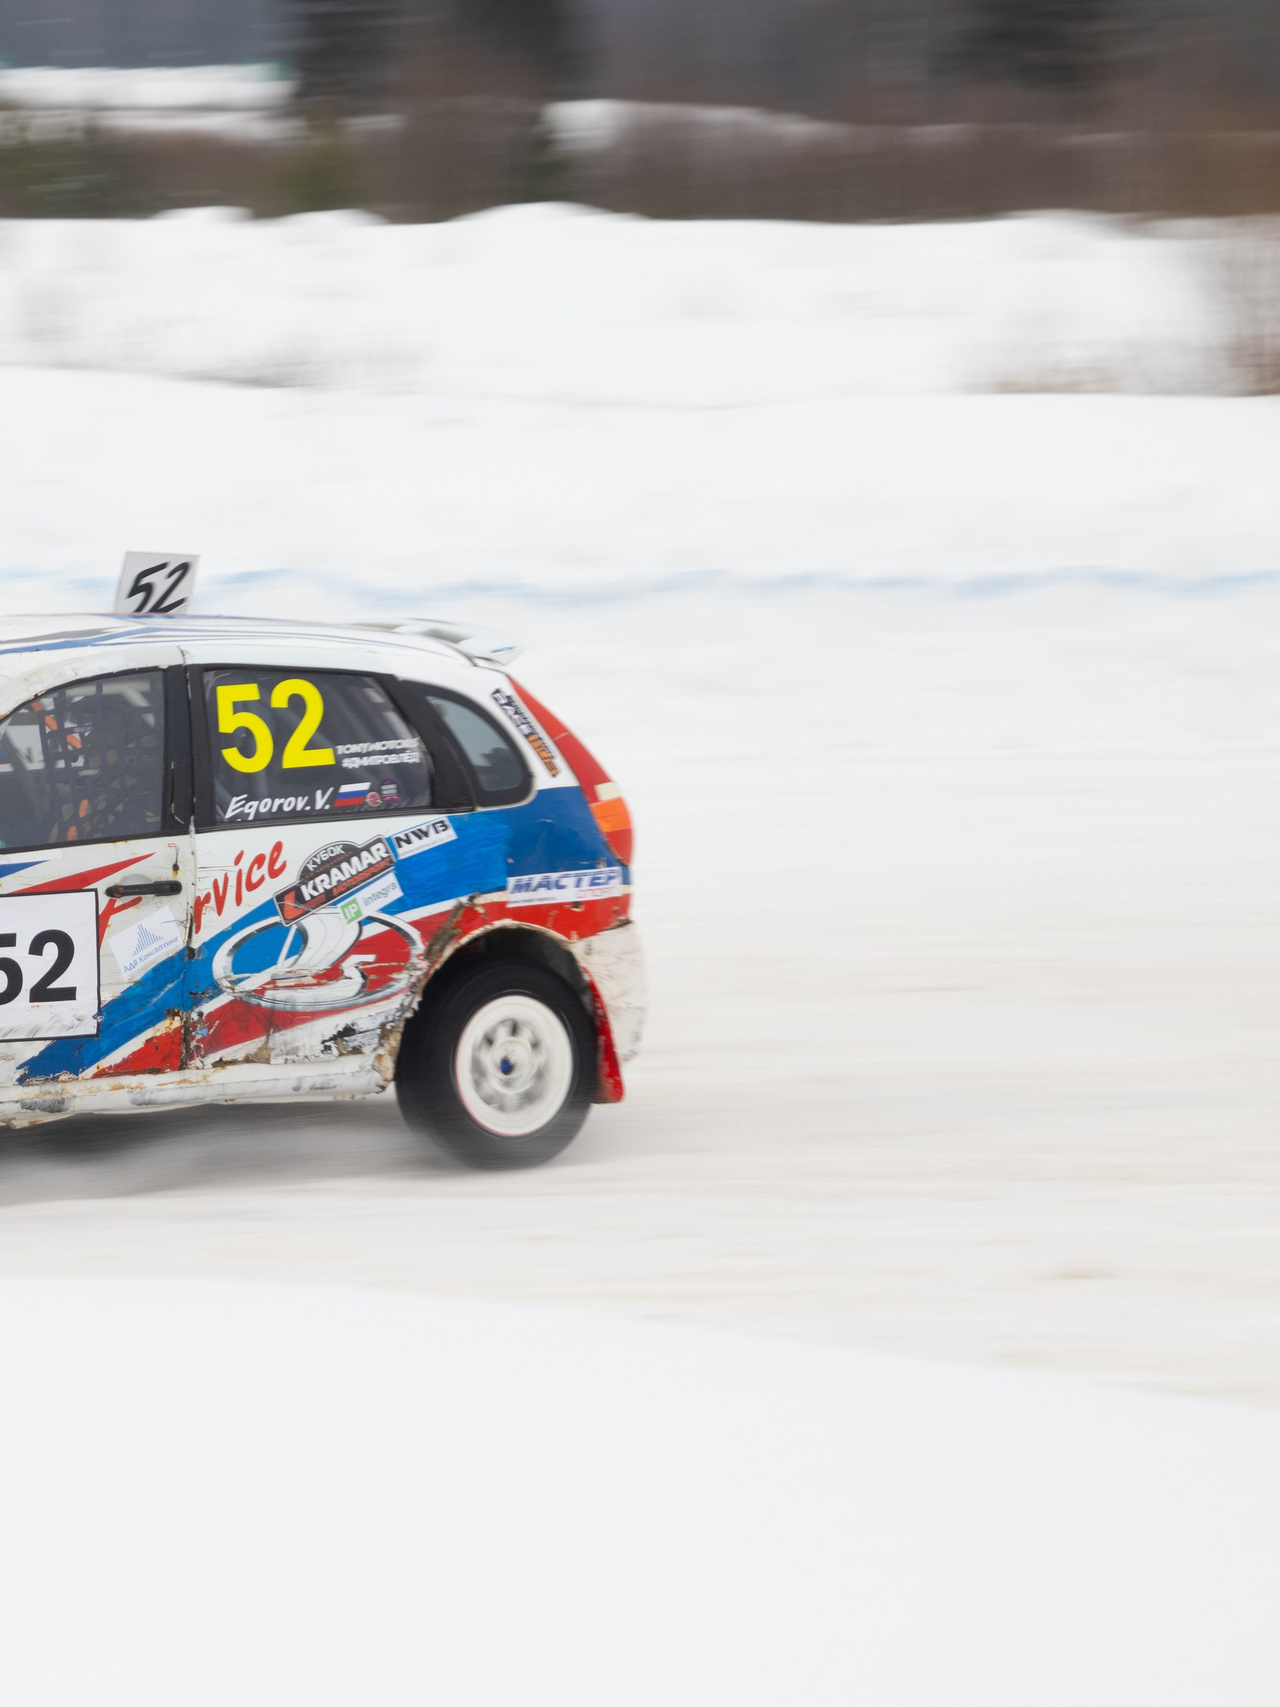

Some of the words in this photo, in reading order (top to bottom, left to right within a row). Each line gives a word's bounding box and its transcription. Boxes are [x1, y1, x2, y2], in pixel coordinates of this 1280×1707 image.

[125, 561, 191, 613] 52
[216, 678, 336, 774] 52
[300, 842, 391, 901] KRAMAR
[306, 844, 348, 872] КУБОК
[510, 869, 621, 895] МАСТЕР
[123, 958, 139, 974] АДВ
[138, 935, 180, 964] Консалтинг
